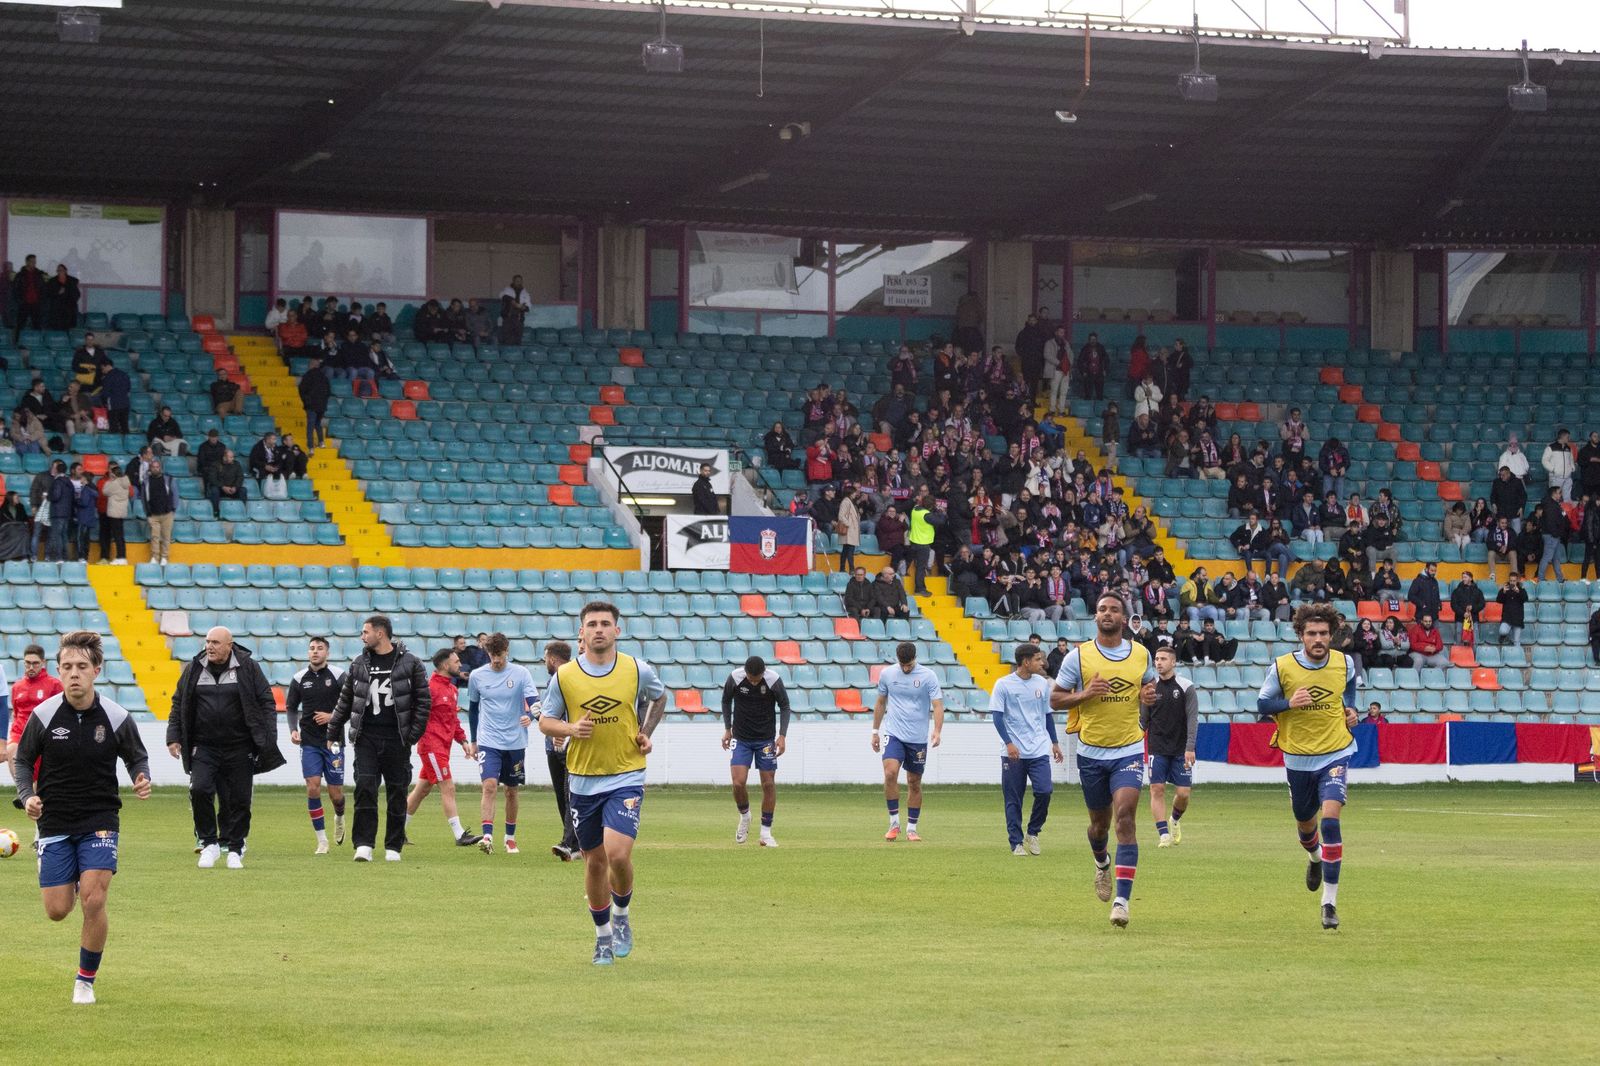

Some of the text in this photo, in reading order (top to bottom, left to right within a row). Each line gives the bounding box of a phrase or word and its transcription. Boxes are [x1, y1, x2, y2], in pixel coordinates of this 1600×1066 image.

[631, 454, 702, 475] ALJOMAR
[701, 523, 730, 543] ALJ
[1100, 694, 1130, 703] umbro
[589, 715, 619, 725] mbro
